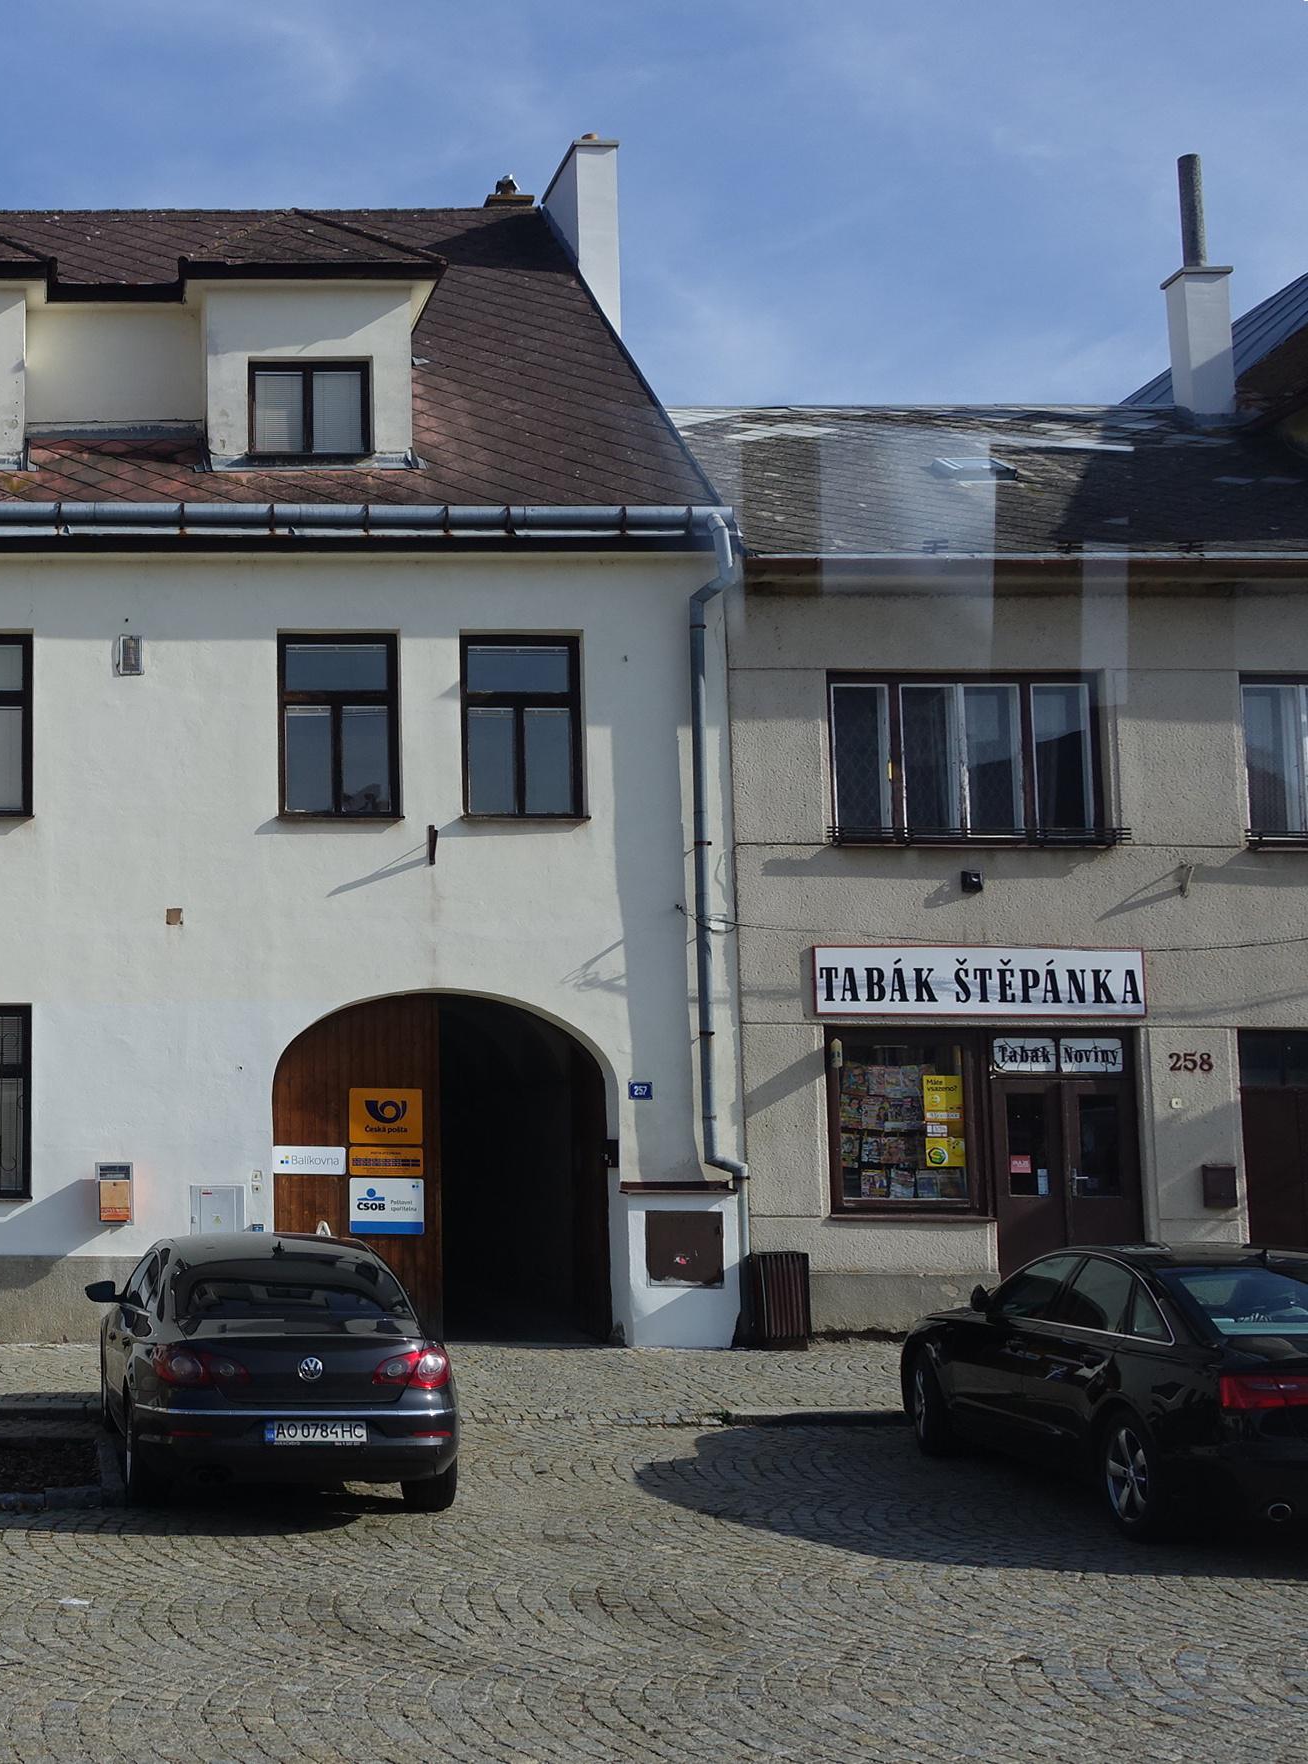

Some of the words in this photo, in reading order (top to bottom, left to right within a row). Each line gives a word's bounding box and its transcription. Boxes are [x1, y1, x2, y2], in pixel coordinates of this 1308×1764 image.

[819, 958, 939, 1003] TABÁK
[955, 958, 1142, 1004] ŠTĚPÁNKA
[1063, 1046, 1119, 1066] Noviny
[1168, 1052, 1214, 1072] 258
[633, 1085, 648, 1096] 257
[364, 1124, 386, 1133] Česká
[387, 1125, 408, 1134] pošta
[291, 1155, 340, 1166] Balíkovna
[357, 1201, 386, 1211] ČSOB
[276, 1423, 298, 1439] AO
[301, 1423, 339, 1439] 0784
[341, 1423, 364, 1439] HC
